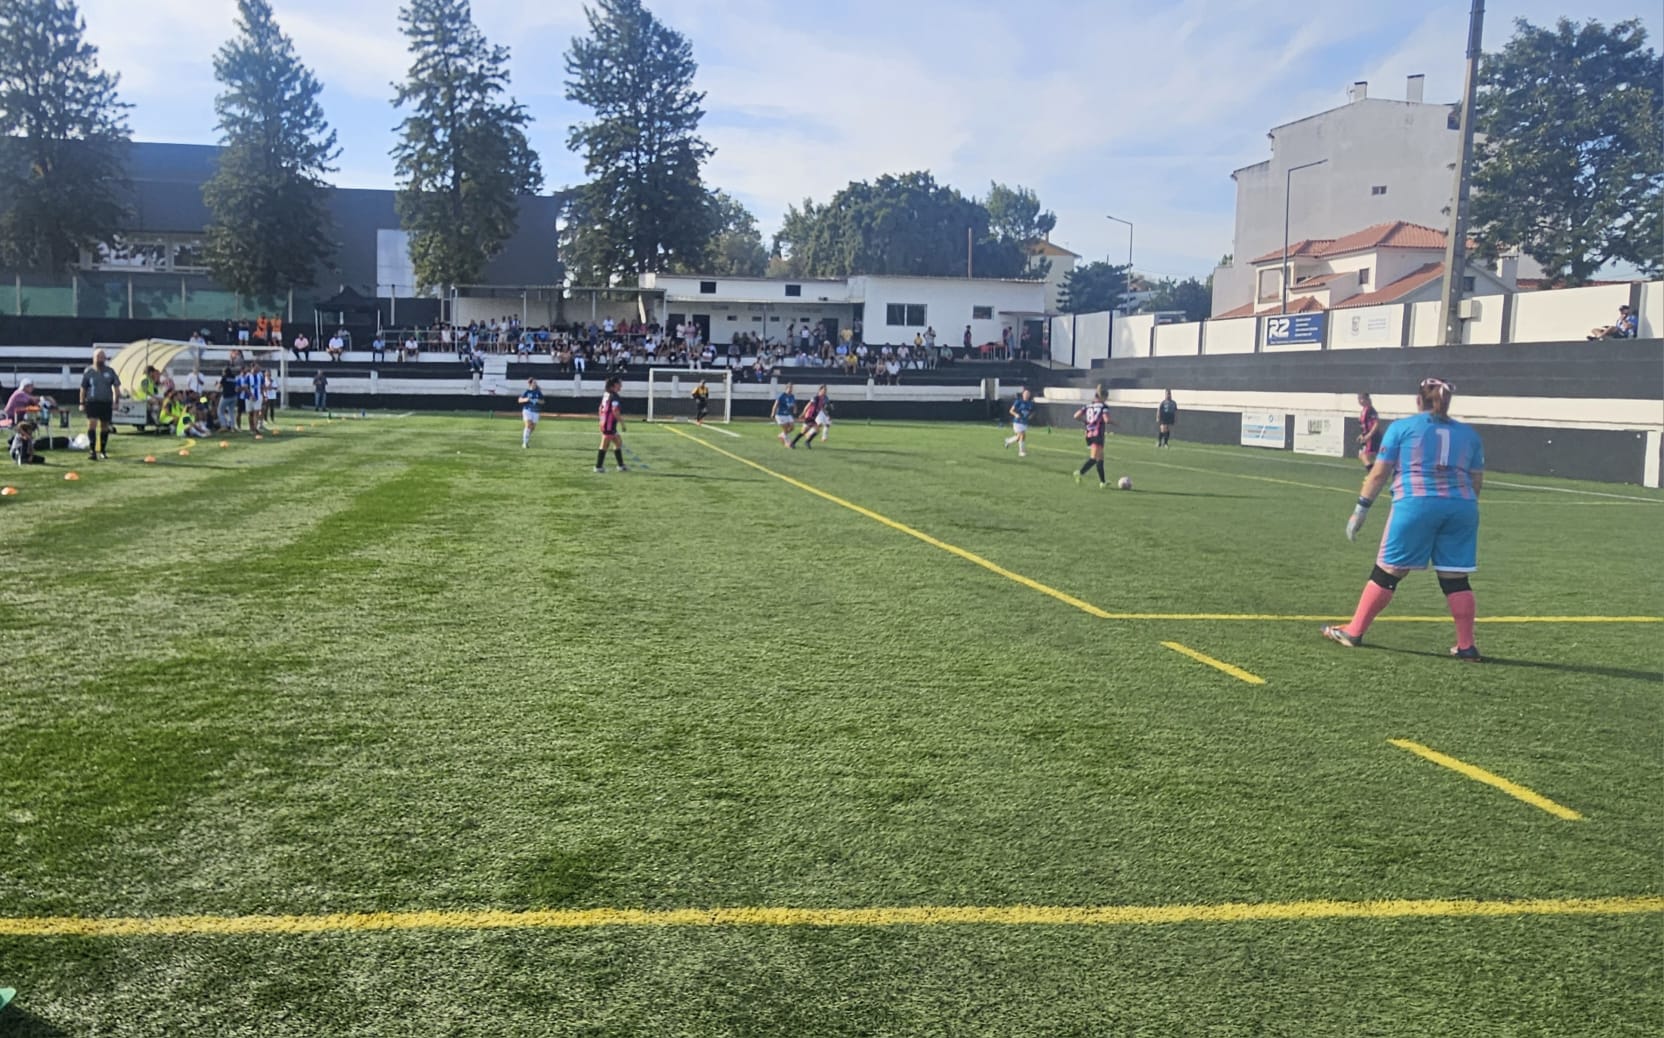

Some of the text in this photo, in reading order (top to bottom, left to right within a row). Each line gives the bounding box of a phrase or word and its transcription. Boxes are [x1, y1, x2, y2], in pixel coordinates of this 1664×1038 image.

[1269, 318, 1290, 338] R2
[1086, 407, 1102, 423] 87
[1436, 429, 1450, 466] 1
